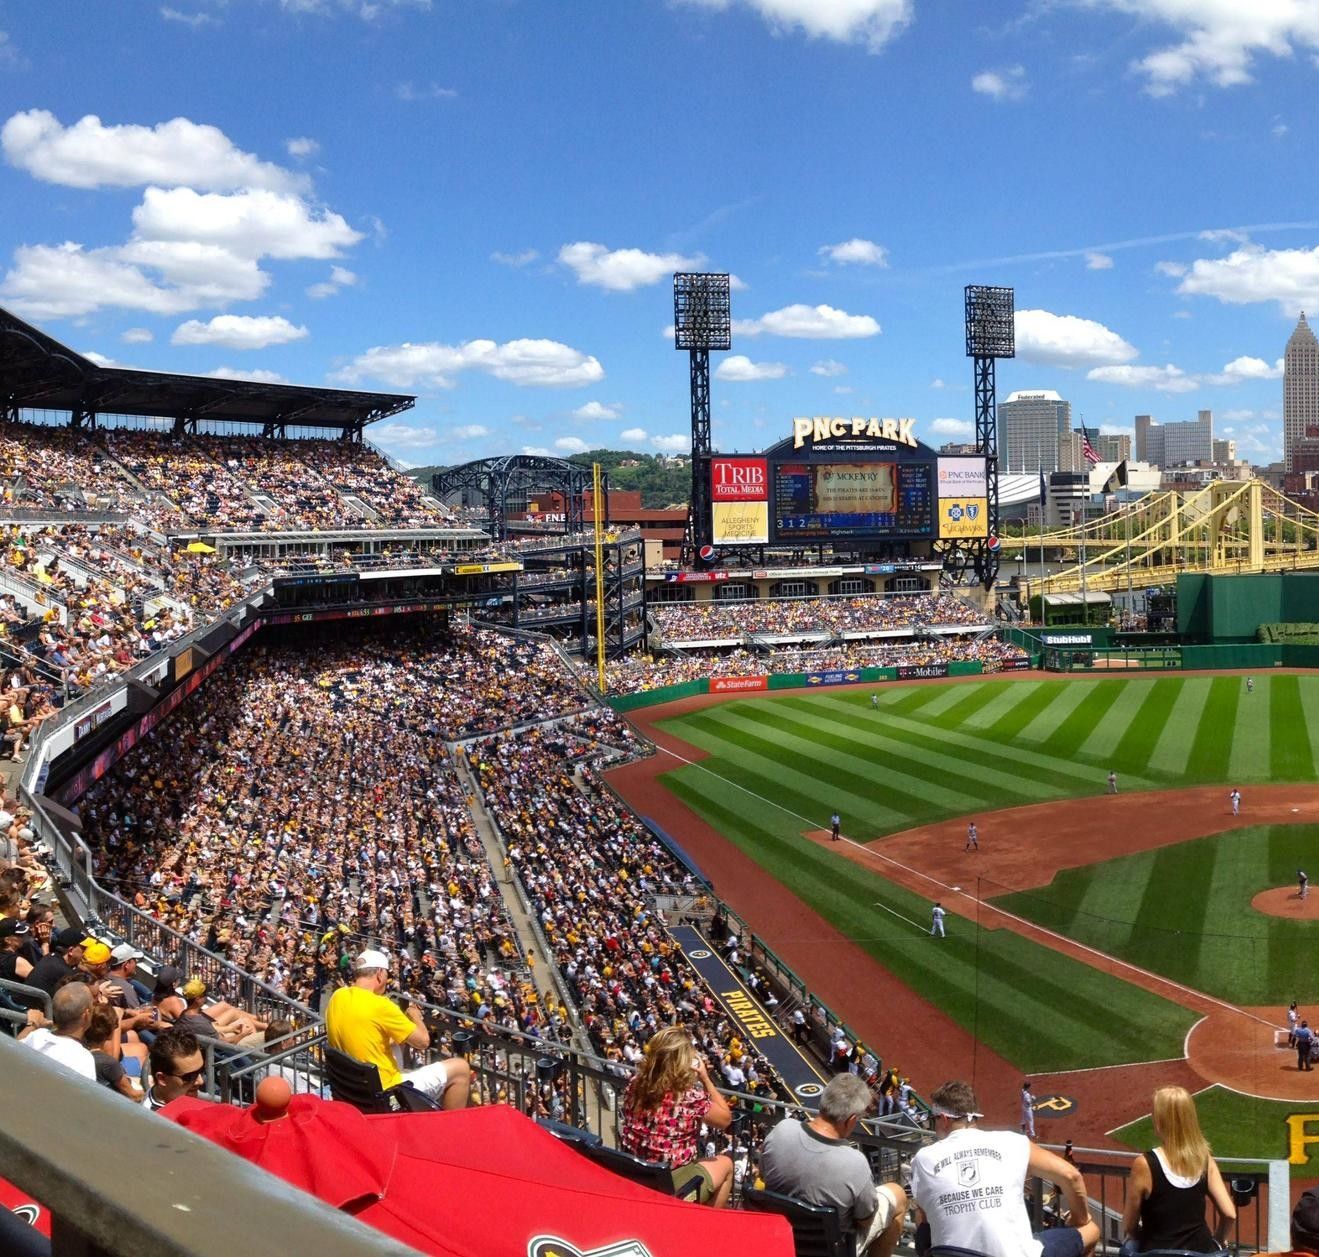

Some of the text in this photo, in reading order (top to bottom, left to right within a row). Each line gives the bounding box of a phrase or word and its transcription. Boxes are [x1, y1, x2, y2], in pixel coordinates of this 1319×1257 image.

[793, 417, 918, 449] PNC PARK
[715, 463, 764, 484] TRIB
[716, 484, 764, 493] TOTAL MEDIA
[777, 520, 784, 528] 3
[788, 520, 794, 528] 1
[799, 520, 806, 528] 2
[720, 990, 777, 1039] PIRATES
[940, 1157, 952, 1169] WILL
[953, 1149, 973, 1160] ALWAYS
[973, 1147, 1002, 1161] REMEMBER
[939, 1186, 1004, 1205] BECAUSE WE CARE
[943, 1198, 1003, 1217] TROPHY CLUB
